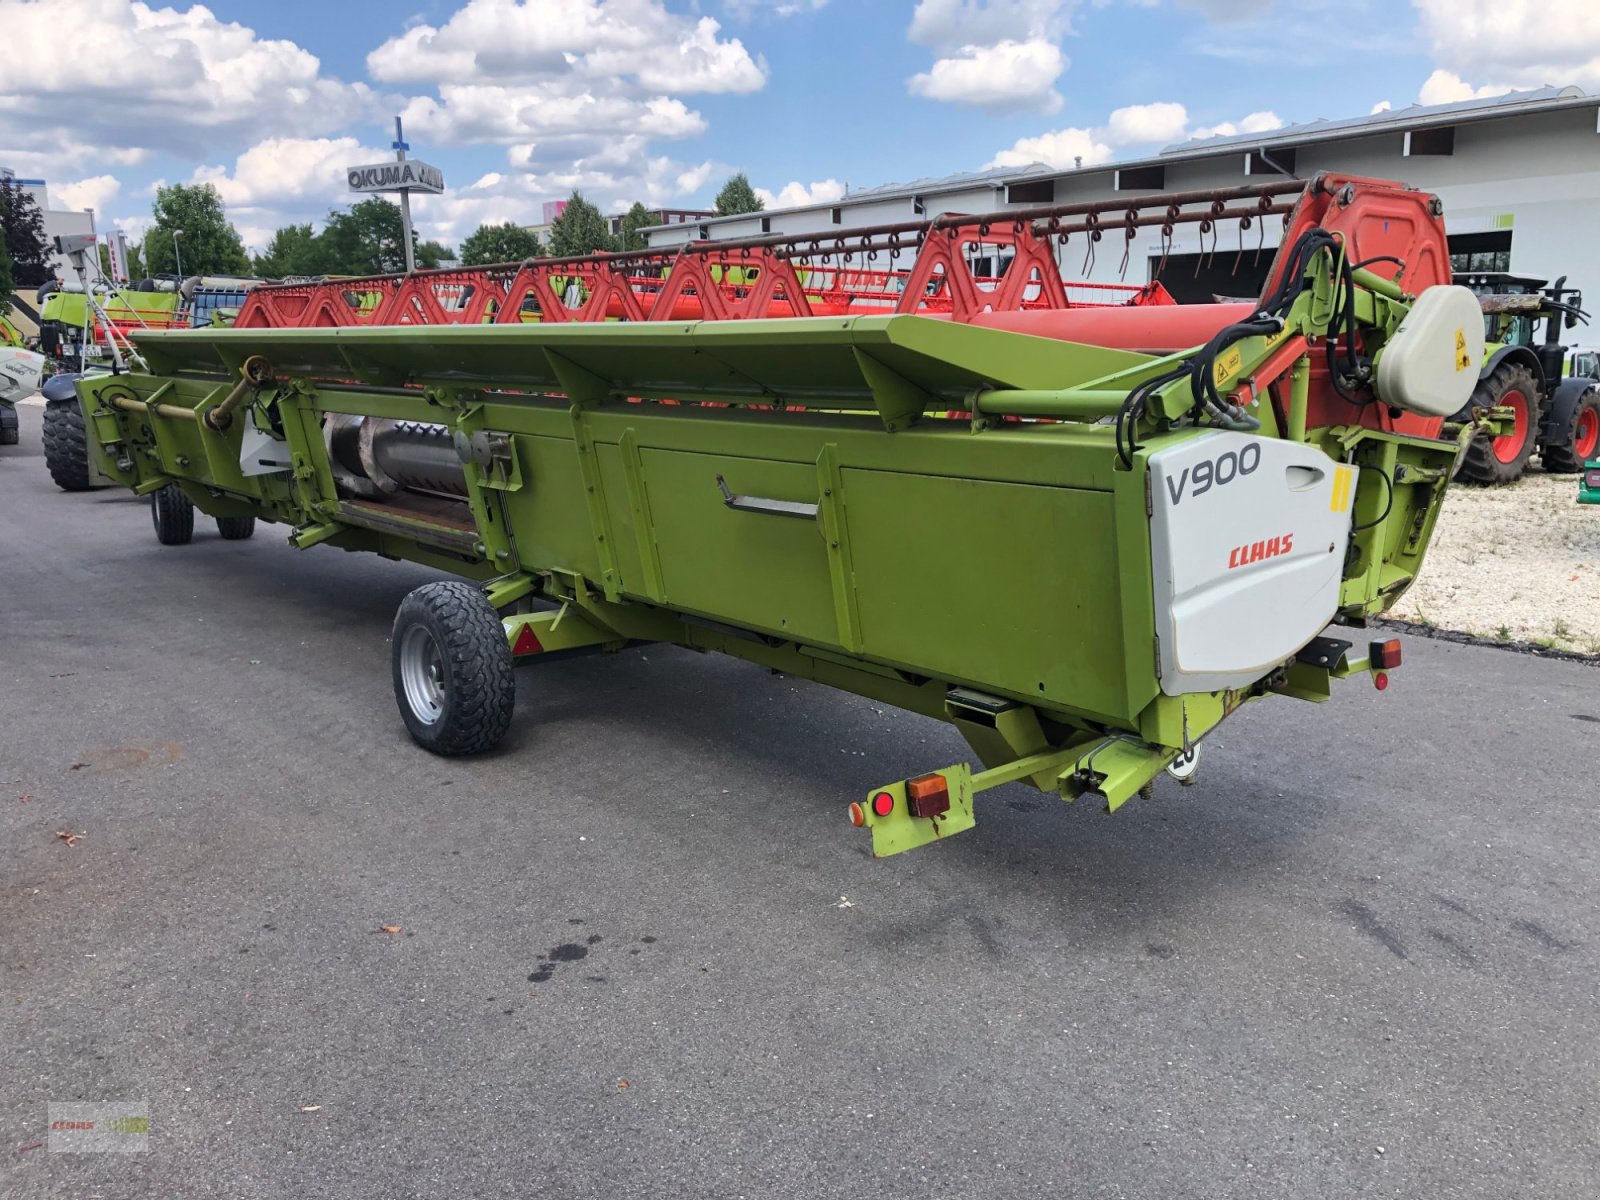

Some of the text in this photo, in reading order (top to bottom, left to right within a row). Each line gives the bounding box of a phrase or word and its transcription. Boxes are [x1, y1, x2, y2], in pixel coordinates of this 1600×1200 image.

[349, 165, 416, 188] OKUMA
[1166, 442, 1261, 506] V900
[1228, 533, 1293, 569] CLAAS
